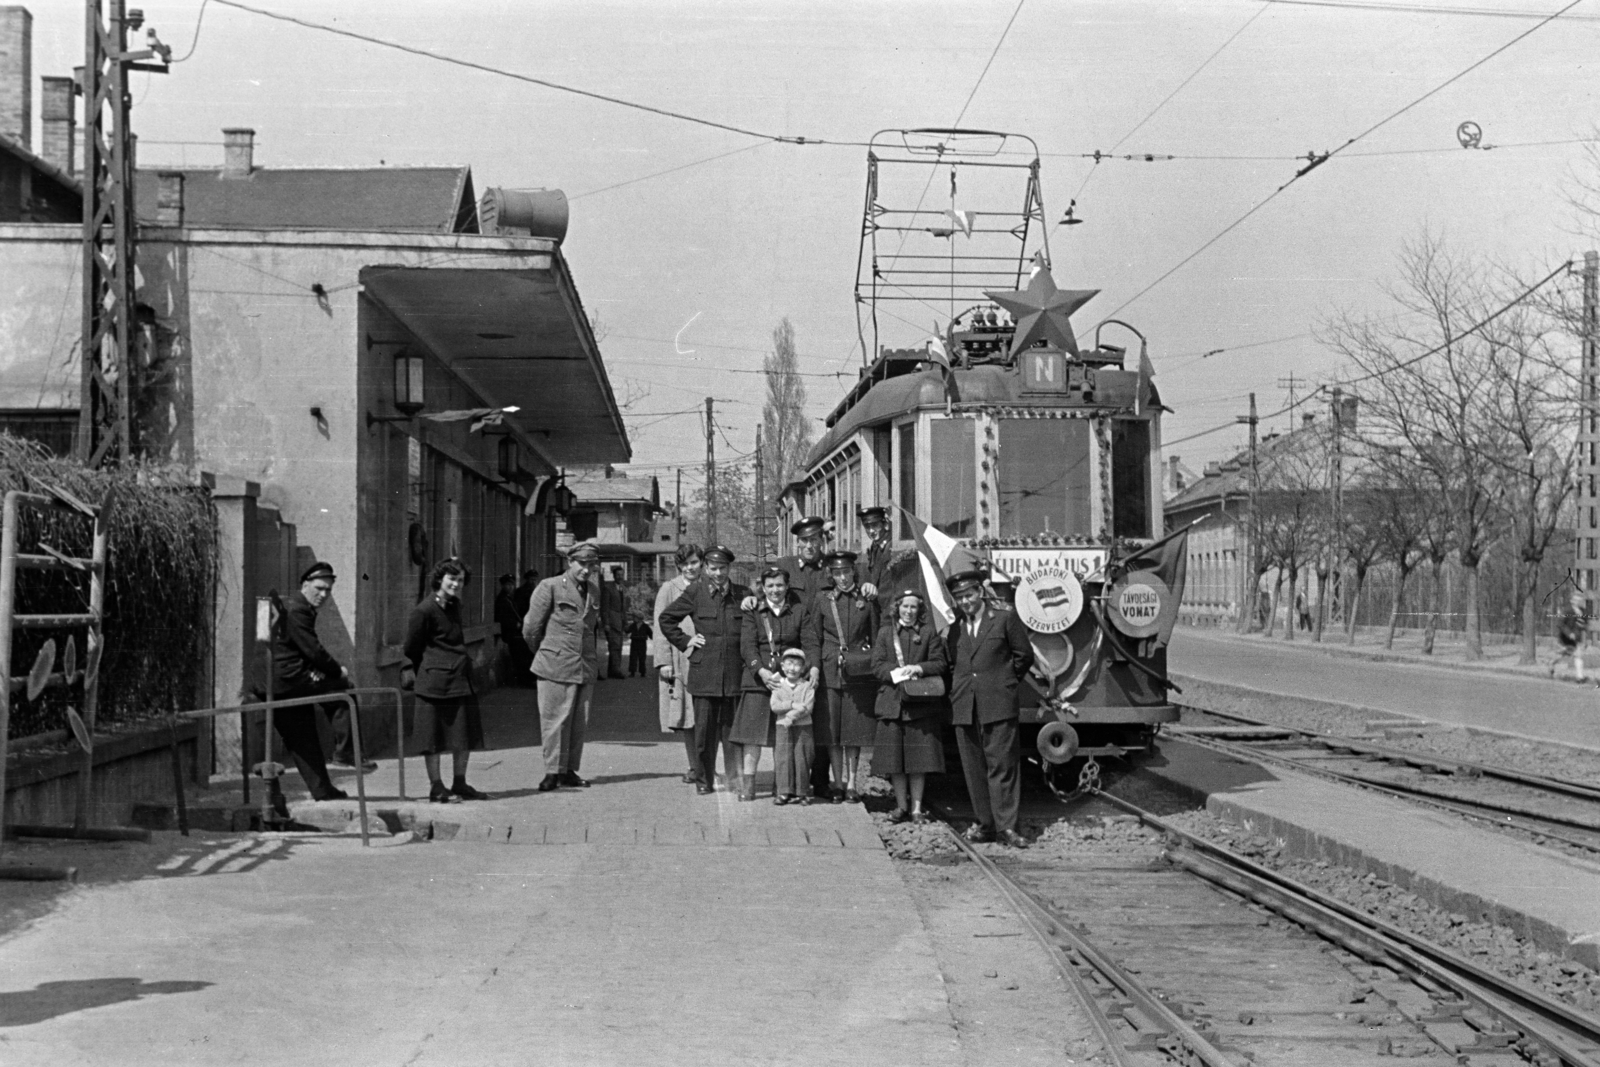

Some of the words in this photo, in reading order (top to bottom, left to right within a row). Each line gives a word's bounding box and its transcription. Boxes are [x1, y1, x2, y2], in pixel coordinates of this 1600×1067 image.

[1035, 355, 1054, 382] N
[1092, 555, 1102, 572] 1
[1025, 567, 1069, 585] BUDAFOKI
[1122, 590, 1158, 604] TÁVOLSÁGI
[1122, 605, 1156, 618] VONAT
[1026, 616, 1071, 631] SZERVEZET
